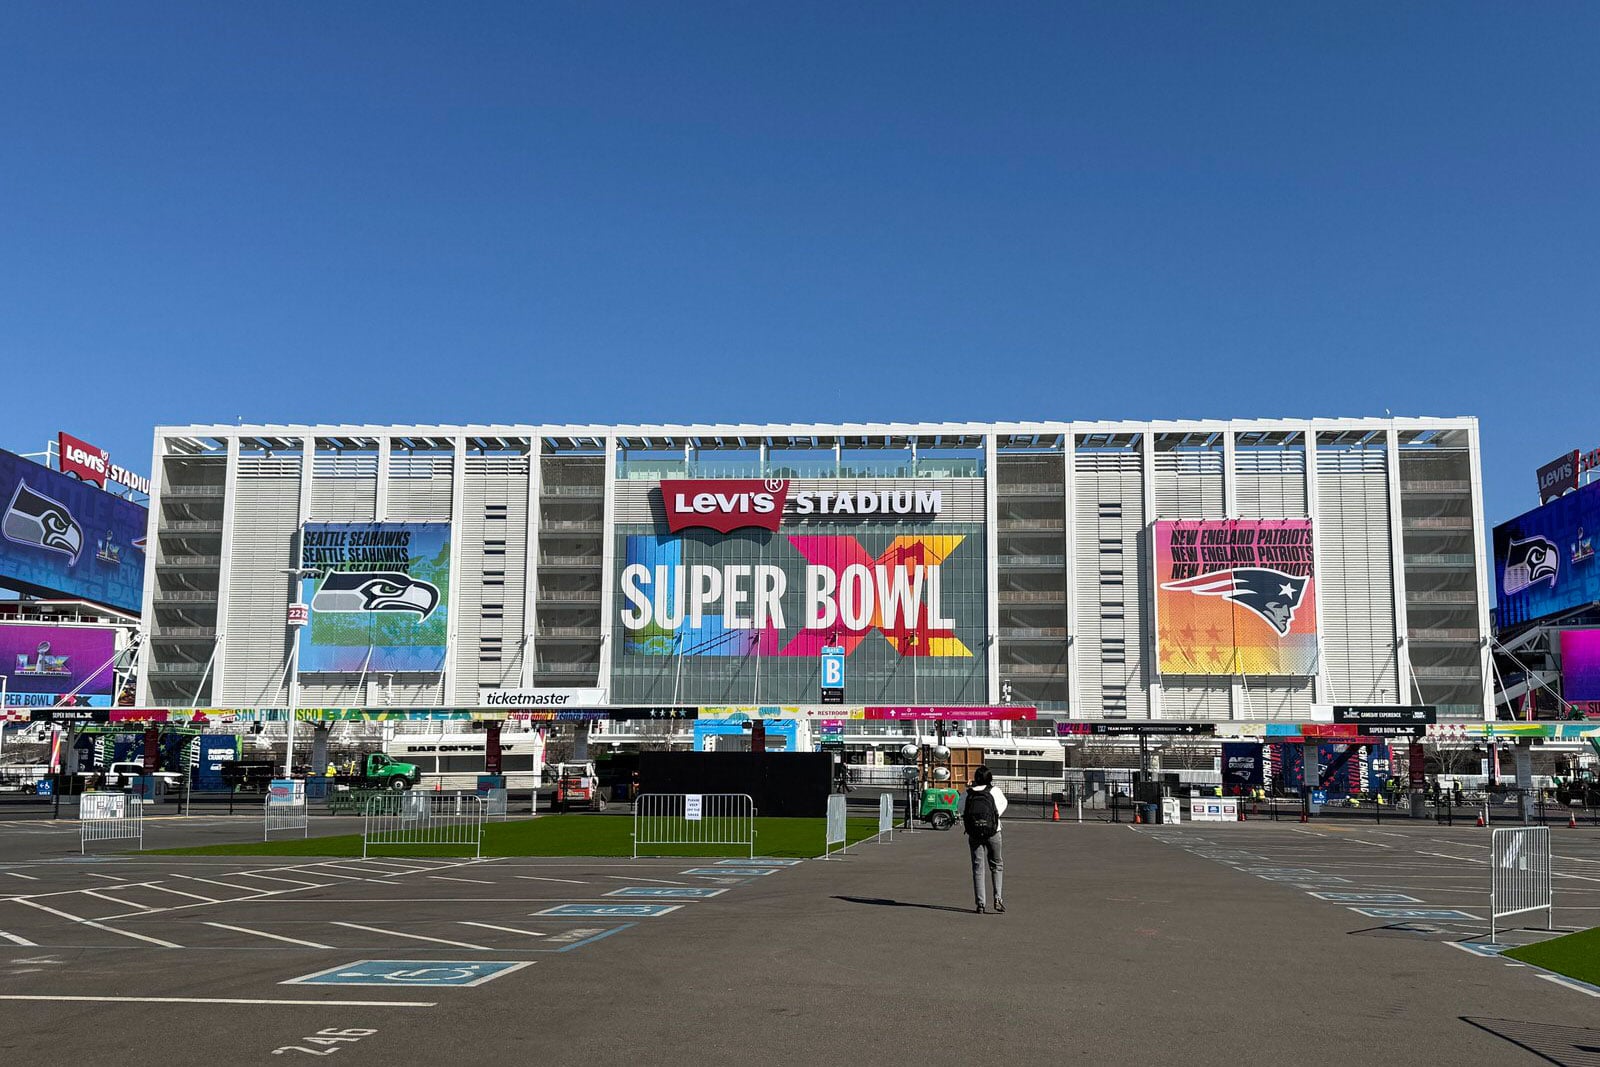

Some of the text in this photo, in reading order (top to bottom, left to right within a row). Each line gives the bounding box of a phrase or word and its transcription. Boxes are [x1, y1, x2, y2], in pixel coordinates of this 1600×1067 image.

[111, 464, 151, 495] STADIU
[675, 492, 775, 513] Levi's
[796, 490, 942, 514] STADIUM
[304, 531, 411, 547] SEATTLE SEAHAWKS
[1171, 529, 1313, 545] NEW ENGLAND PATRIOTS
[303, 547, 409, 562] SEATTLE SEAHAWKS
[1171, 546, 1314, 562] NEW ENGLAND PATRIOTS
[1171, 562, 1199, 579] NEW
[620, 564, 956, 631] SUPER BOWL
[826, 659, 840, 684] B
[486, 692, 570, 705] ticketmaster
[235, 708, 256, 721] SAN
[271, 1028, 378, 1056] 246
